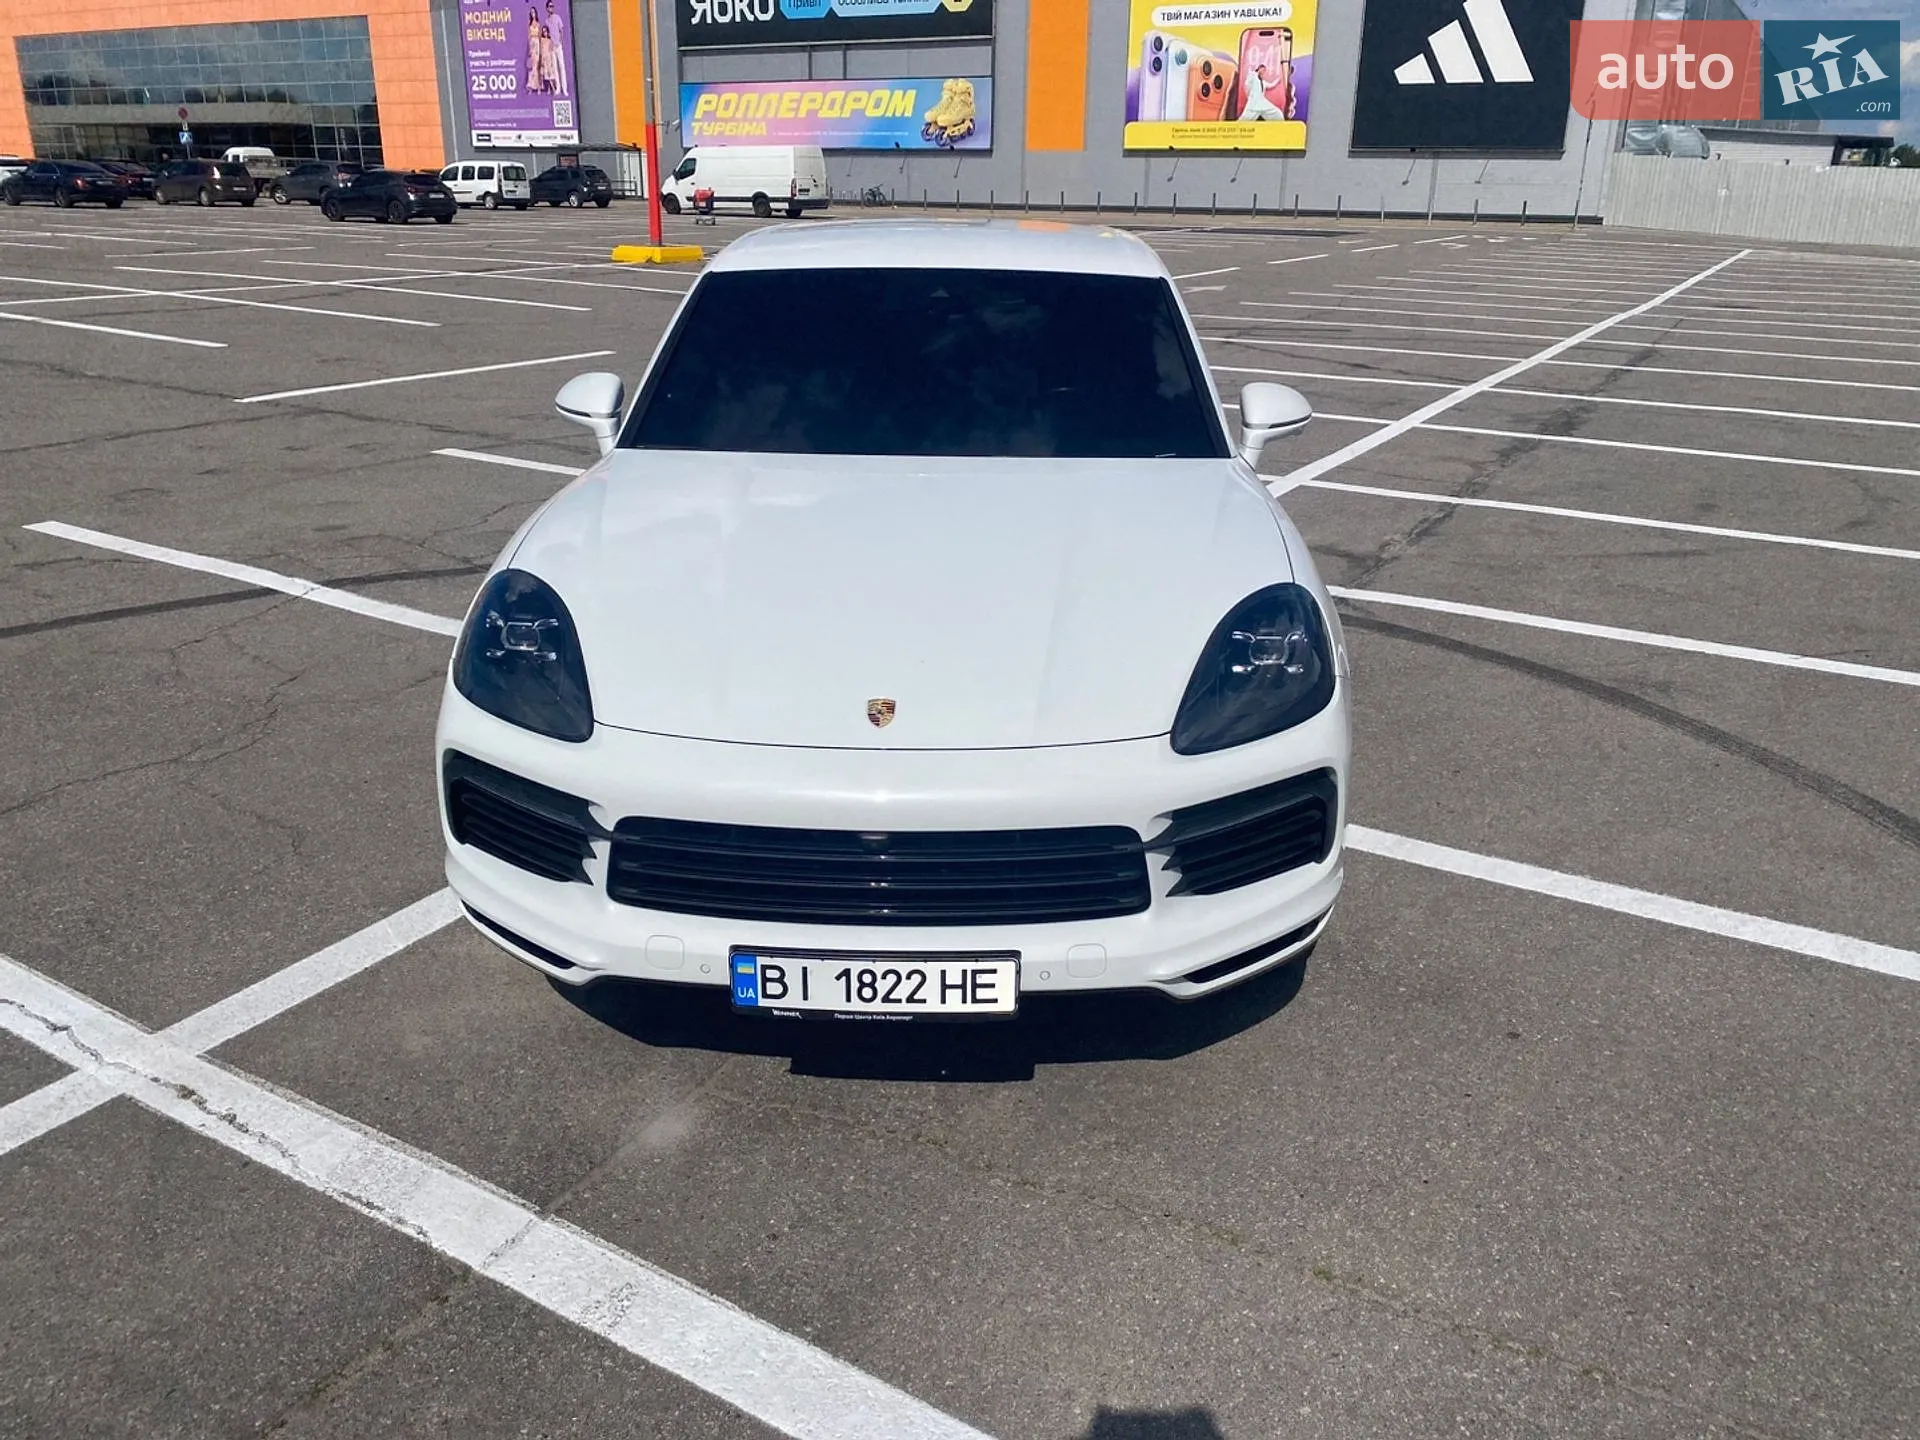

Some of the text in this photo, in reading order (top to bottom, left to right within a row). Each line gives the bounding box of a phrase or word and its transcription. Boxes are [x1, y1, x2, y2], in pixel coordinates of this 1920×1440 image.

[465, 7, 512, 26] МОДНИЙ
[1160, 7, 1282, 21] ТВІЙ МАГАЗИН YABLUKA!
[466, 27, 506, 42] ВІКЕНД
[471, 74, 516, 91] 25 000
[693, 89, 918, 119] РОЛЛЕРДРОМ
[691, 120, 768, 137] ТУРБІНА
[760, 963, 999, 1005] BI 1822 HE
[737, 987, 756, 999] UA
